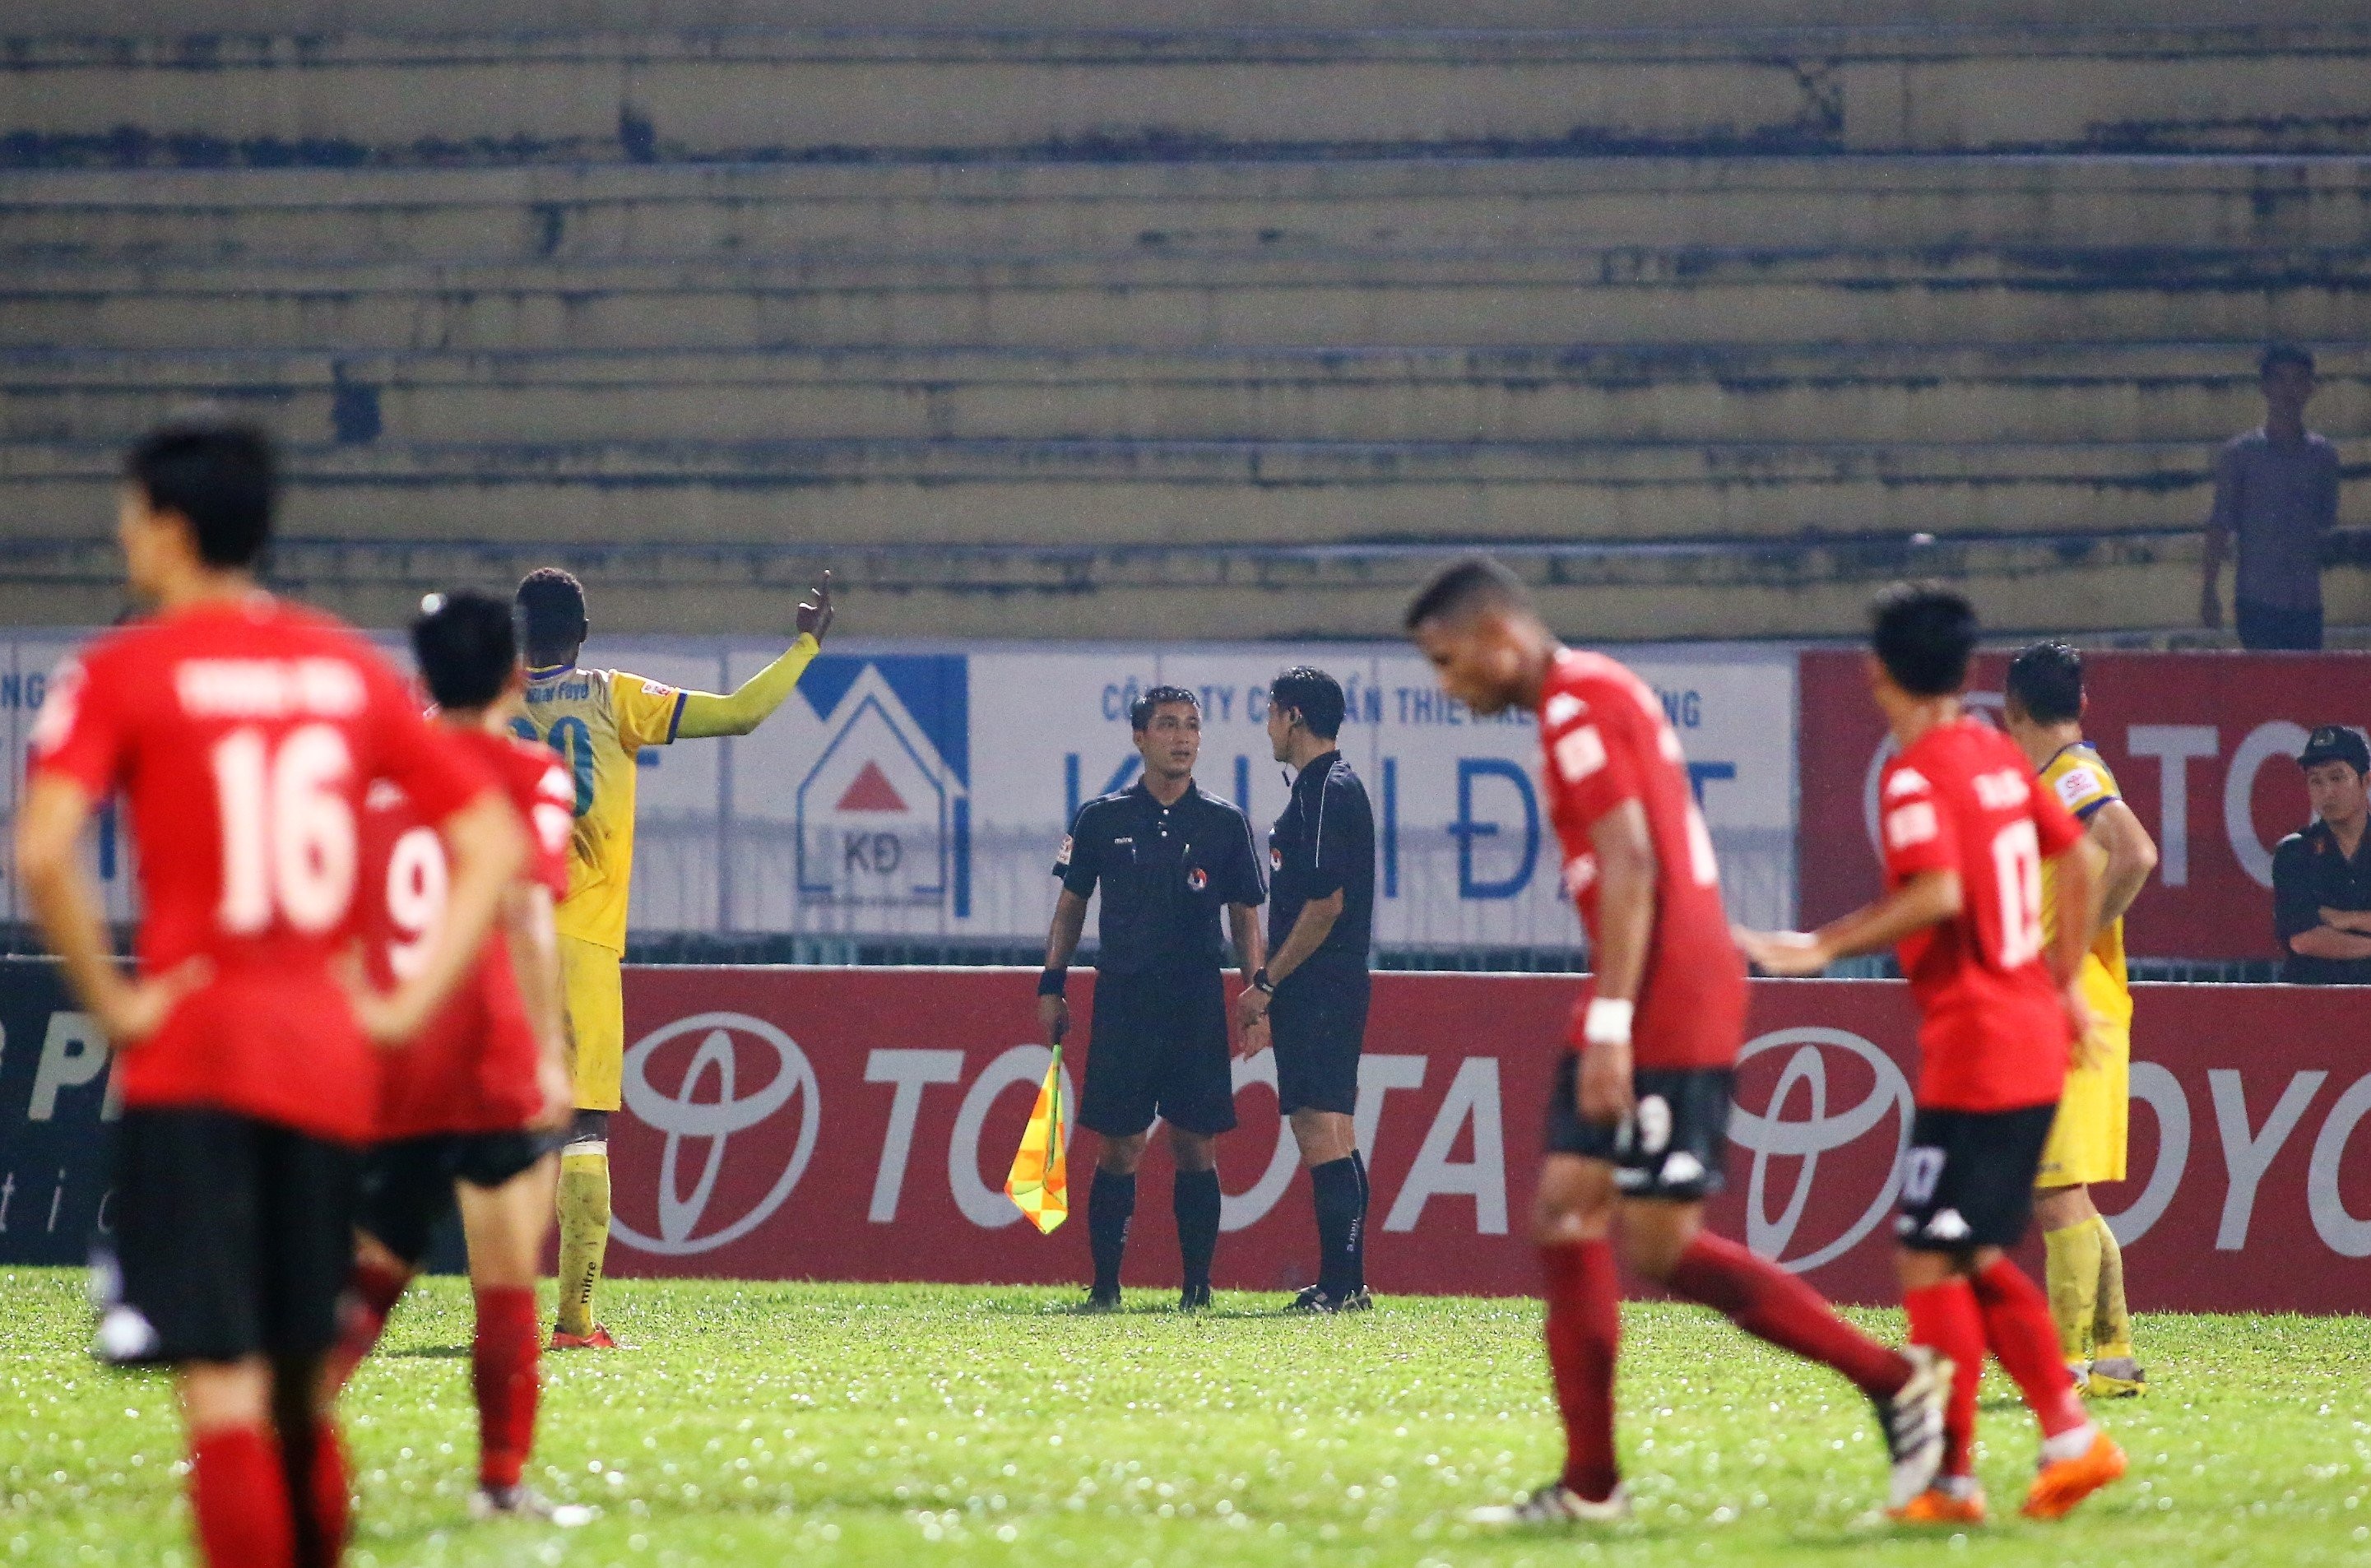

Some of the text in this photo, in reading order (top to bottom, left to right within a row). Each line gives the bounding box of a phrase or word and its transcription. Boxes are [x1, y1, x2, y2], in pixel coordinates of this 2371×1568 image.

[508, 715, 594, 817] 0
[1198, 684, 1235, 721] TY
[212, 722, 358, 936] 16
[2127, 720, 2371, 888] TO
[385, 825, 451, 981] 9
[865, 1043, 1509, 1234] TOOTA
[2100, 1060, 2371, 1257] OYO
[580, 1260, 596, 1304] mitre
